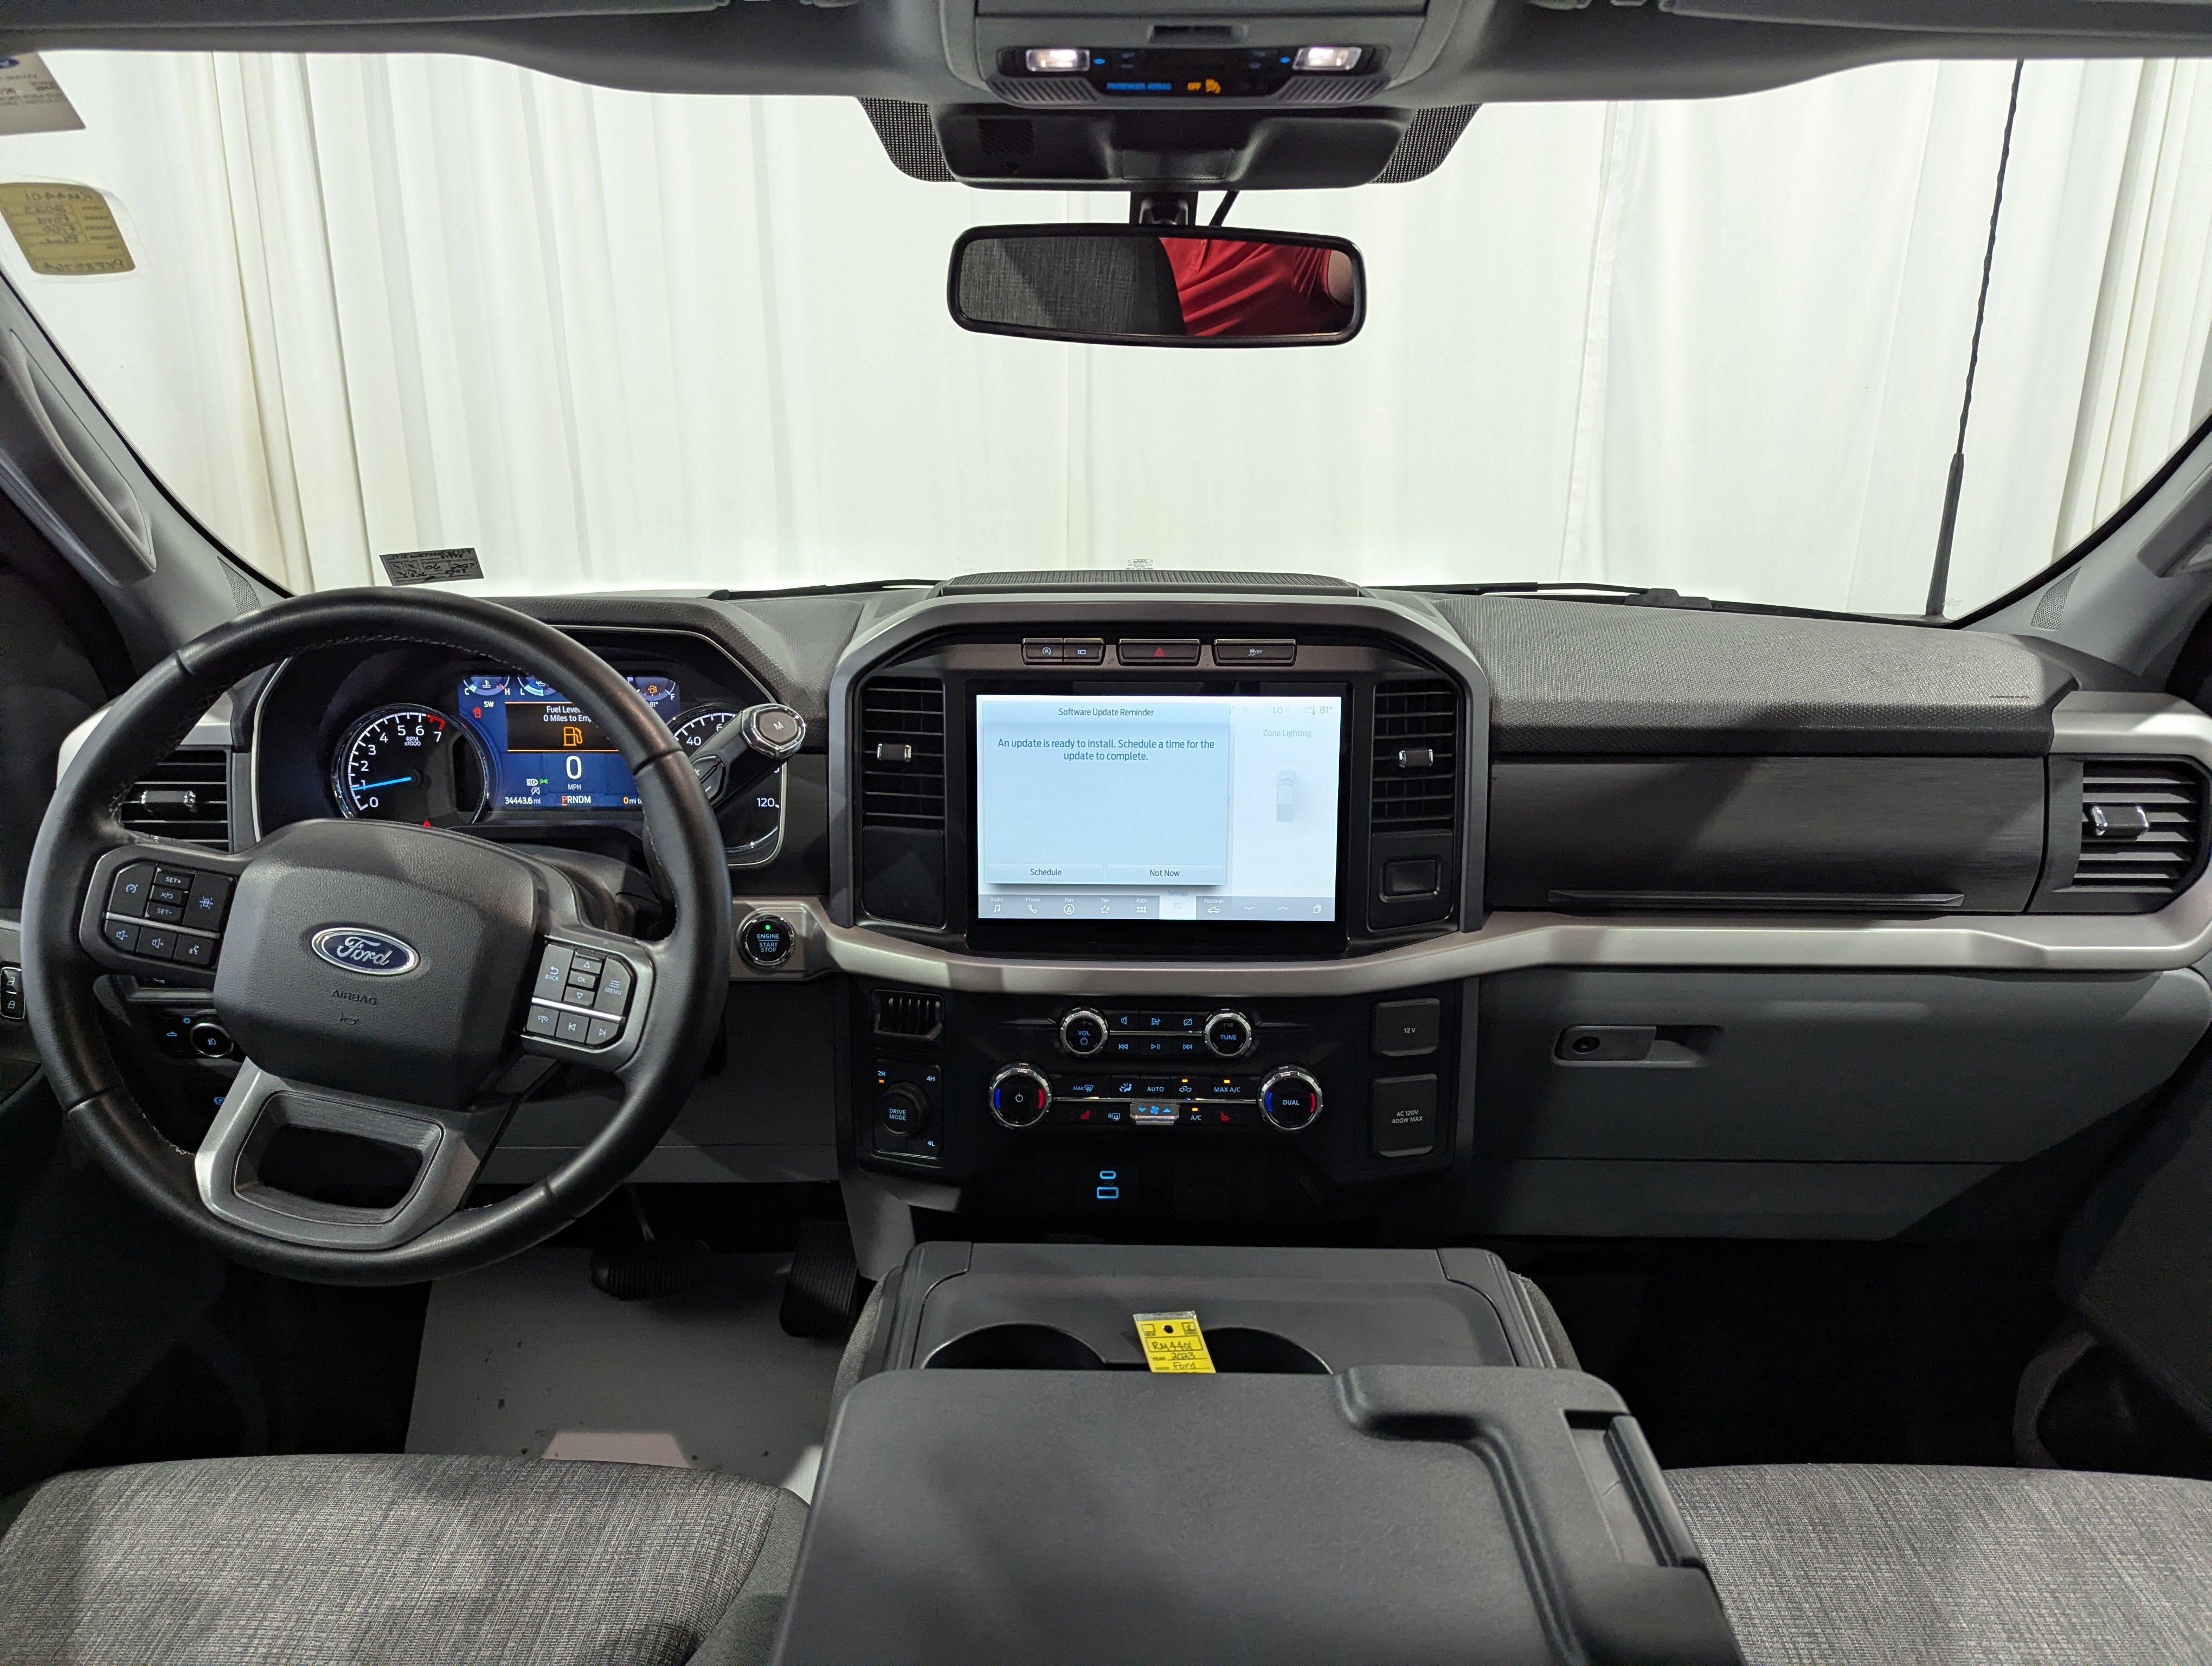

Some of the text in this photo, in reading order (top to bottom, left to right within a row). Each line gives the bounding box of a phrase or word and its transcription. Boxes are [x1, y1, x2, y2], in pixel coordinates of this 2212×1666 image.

[1058, 708, 1154, 717] Software Update Reminder
[578, 714, 592, 723] Em
[397, 725, 406, 736] 5
[415, 725, 425, 736] 6
[773, 721, 784, 731] M
[380, 732, 389, 743] 4
[434, 731, 442, 742] 7
[1282, 729, 1312, 738] Lighting
[686, 736, 702, 746] 40
[998, 739, 1009, 747] An
[1011, 739, 1042, 748] update
[1043, 739, 1050, 747] is
[1051, 739, 1075, 749] ready
[1077, 740, 1086, 748] to
[1088, 739, 1116, 748] install.
[1118, 739, 1156, 748] Schedule
[1165, 739, 1185, 748] time
[1186, 740, 1199, 748] for
[1200, 740, 1214, 748] the
[368, 744, 376, 755] 3
[1064, 752, 1148, 761] update to complete.
[361, 760, 369, 772] 2
[566, 755, 582, 779] 0
[361, 780, 366, 791] 1
[369, 797, 379, 808] 0
[756, 798, 775, 807] 120
[336, 936, 393, 966] Ford
[332, 989, 378, 1005] AIRBAG
[605, 987, 622, 996] MENU
